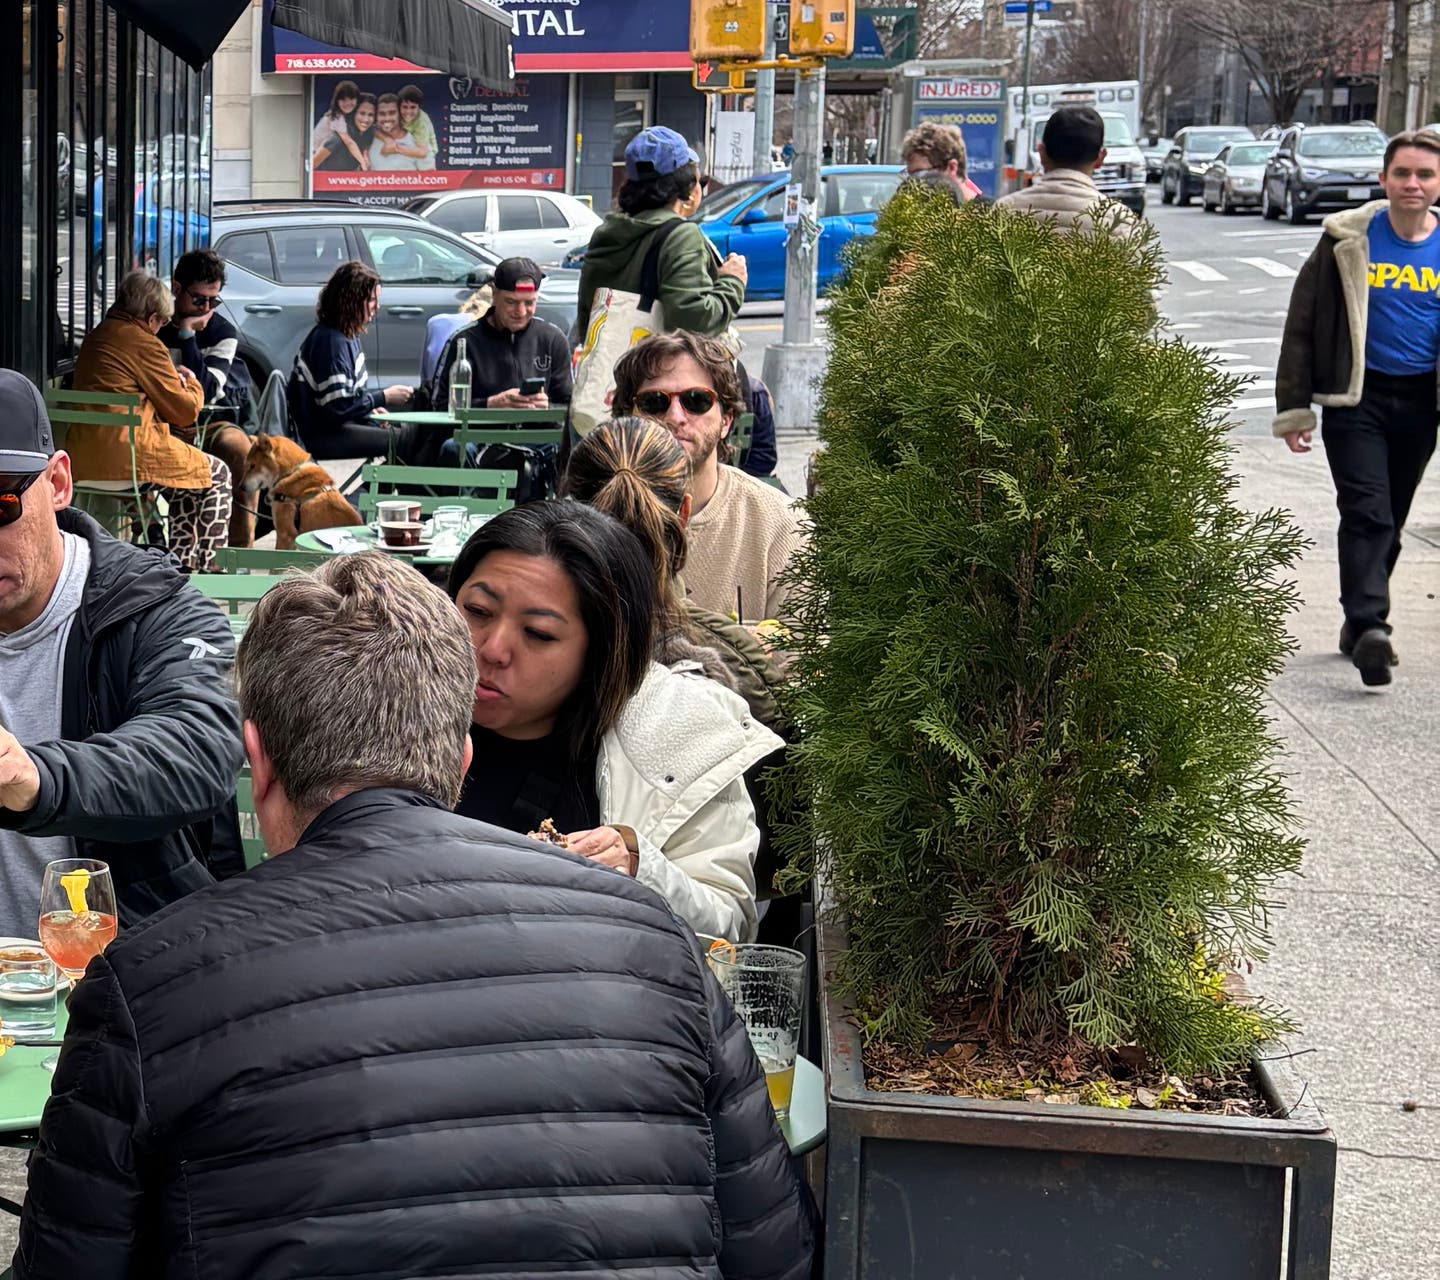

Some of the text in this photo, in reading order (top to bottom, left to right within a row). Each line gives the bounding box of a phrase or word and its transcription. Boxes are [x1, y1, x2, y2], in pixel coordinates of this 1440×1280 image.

[286, 58, 357, 69] 718.638.6002
[921, 83, 1000, 96] INJURED?
[450, 103, 529, 112] Cosmetic Dentistry
[450, 114, 515, 123] Dental Implants
[449, 124, 539, 133] Laser Gum Treatment
[449, 135, 516, 145] Laser Whitening
[449, 146, 473, 155] Botox
[448, 156, 530, 166] Emergency Services
[328, 175, 448, 187] www.gertsdental.com
[483, 176, 528, 184] FIND US ON
[365, 196, 396, 205] ACCEPT
